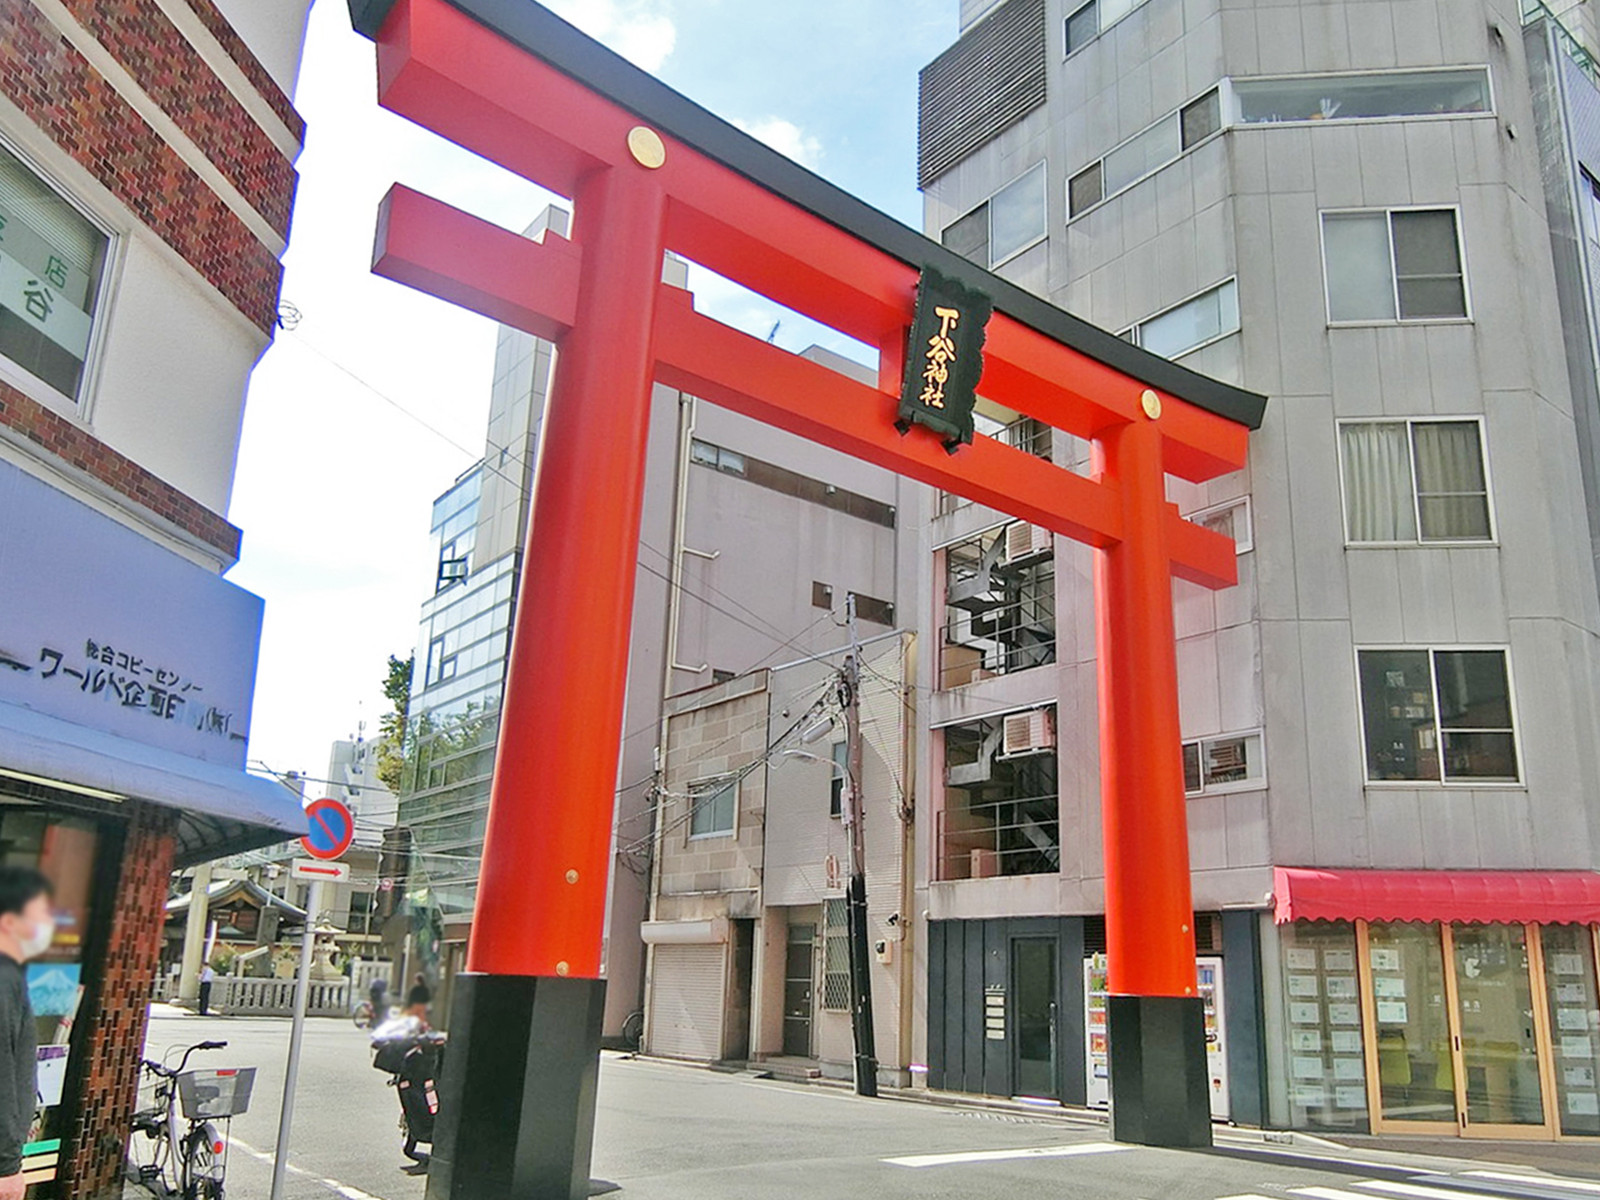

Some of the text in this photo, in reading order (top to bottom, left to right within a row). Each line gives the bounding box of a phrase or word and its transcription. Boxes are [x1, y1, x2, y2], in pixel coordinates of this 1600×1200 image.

[24, 280, 54, 322] 谷
[919, 306, 960, 410] 下谷神社
